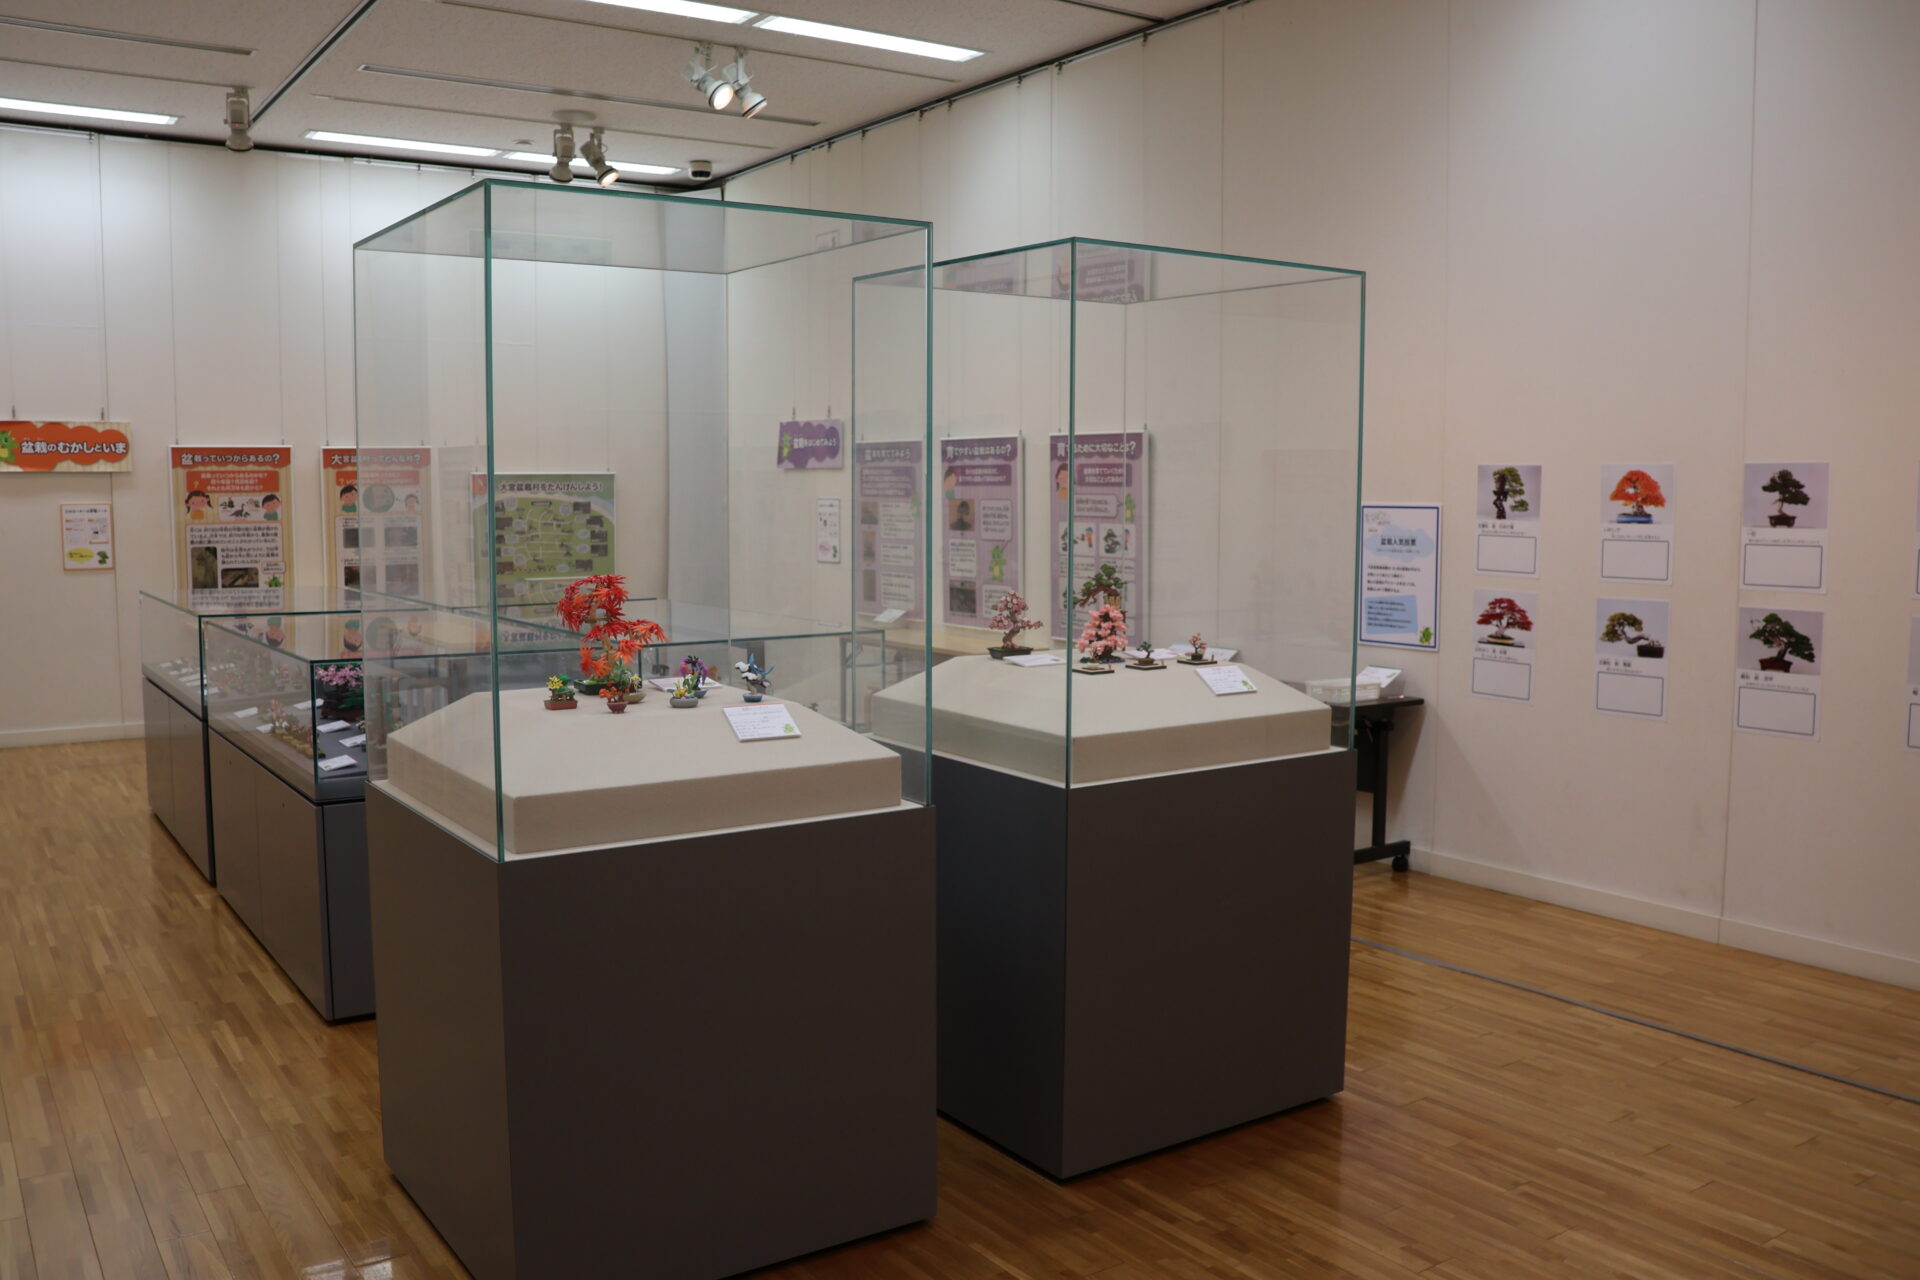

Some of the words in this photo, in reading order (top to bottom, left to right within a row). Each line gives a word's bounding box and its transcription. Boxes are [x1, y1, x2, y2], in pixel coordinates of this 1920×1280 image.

[21, 441, 127, 454] 盆栽のむかしといま
[181, 453, 280, 465] 盆栽っていつからあるの？
